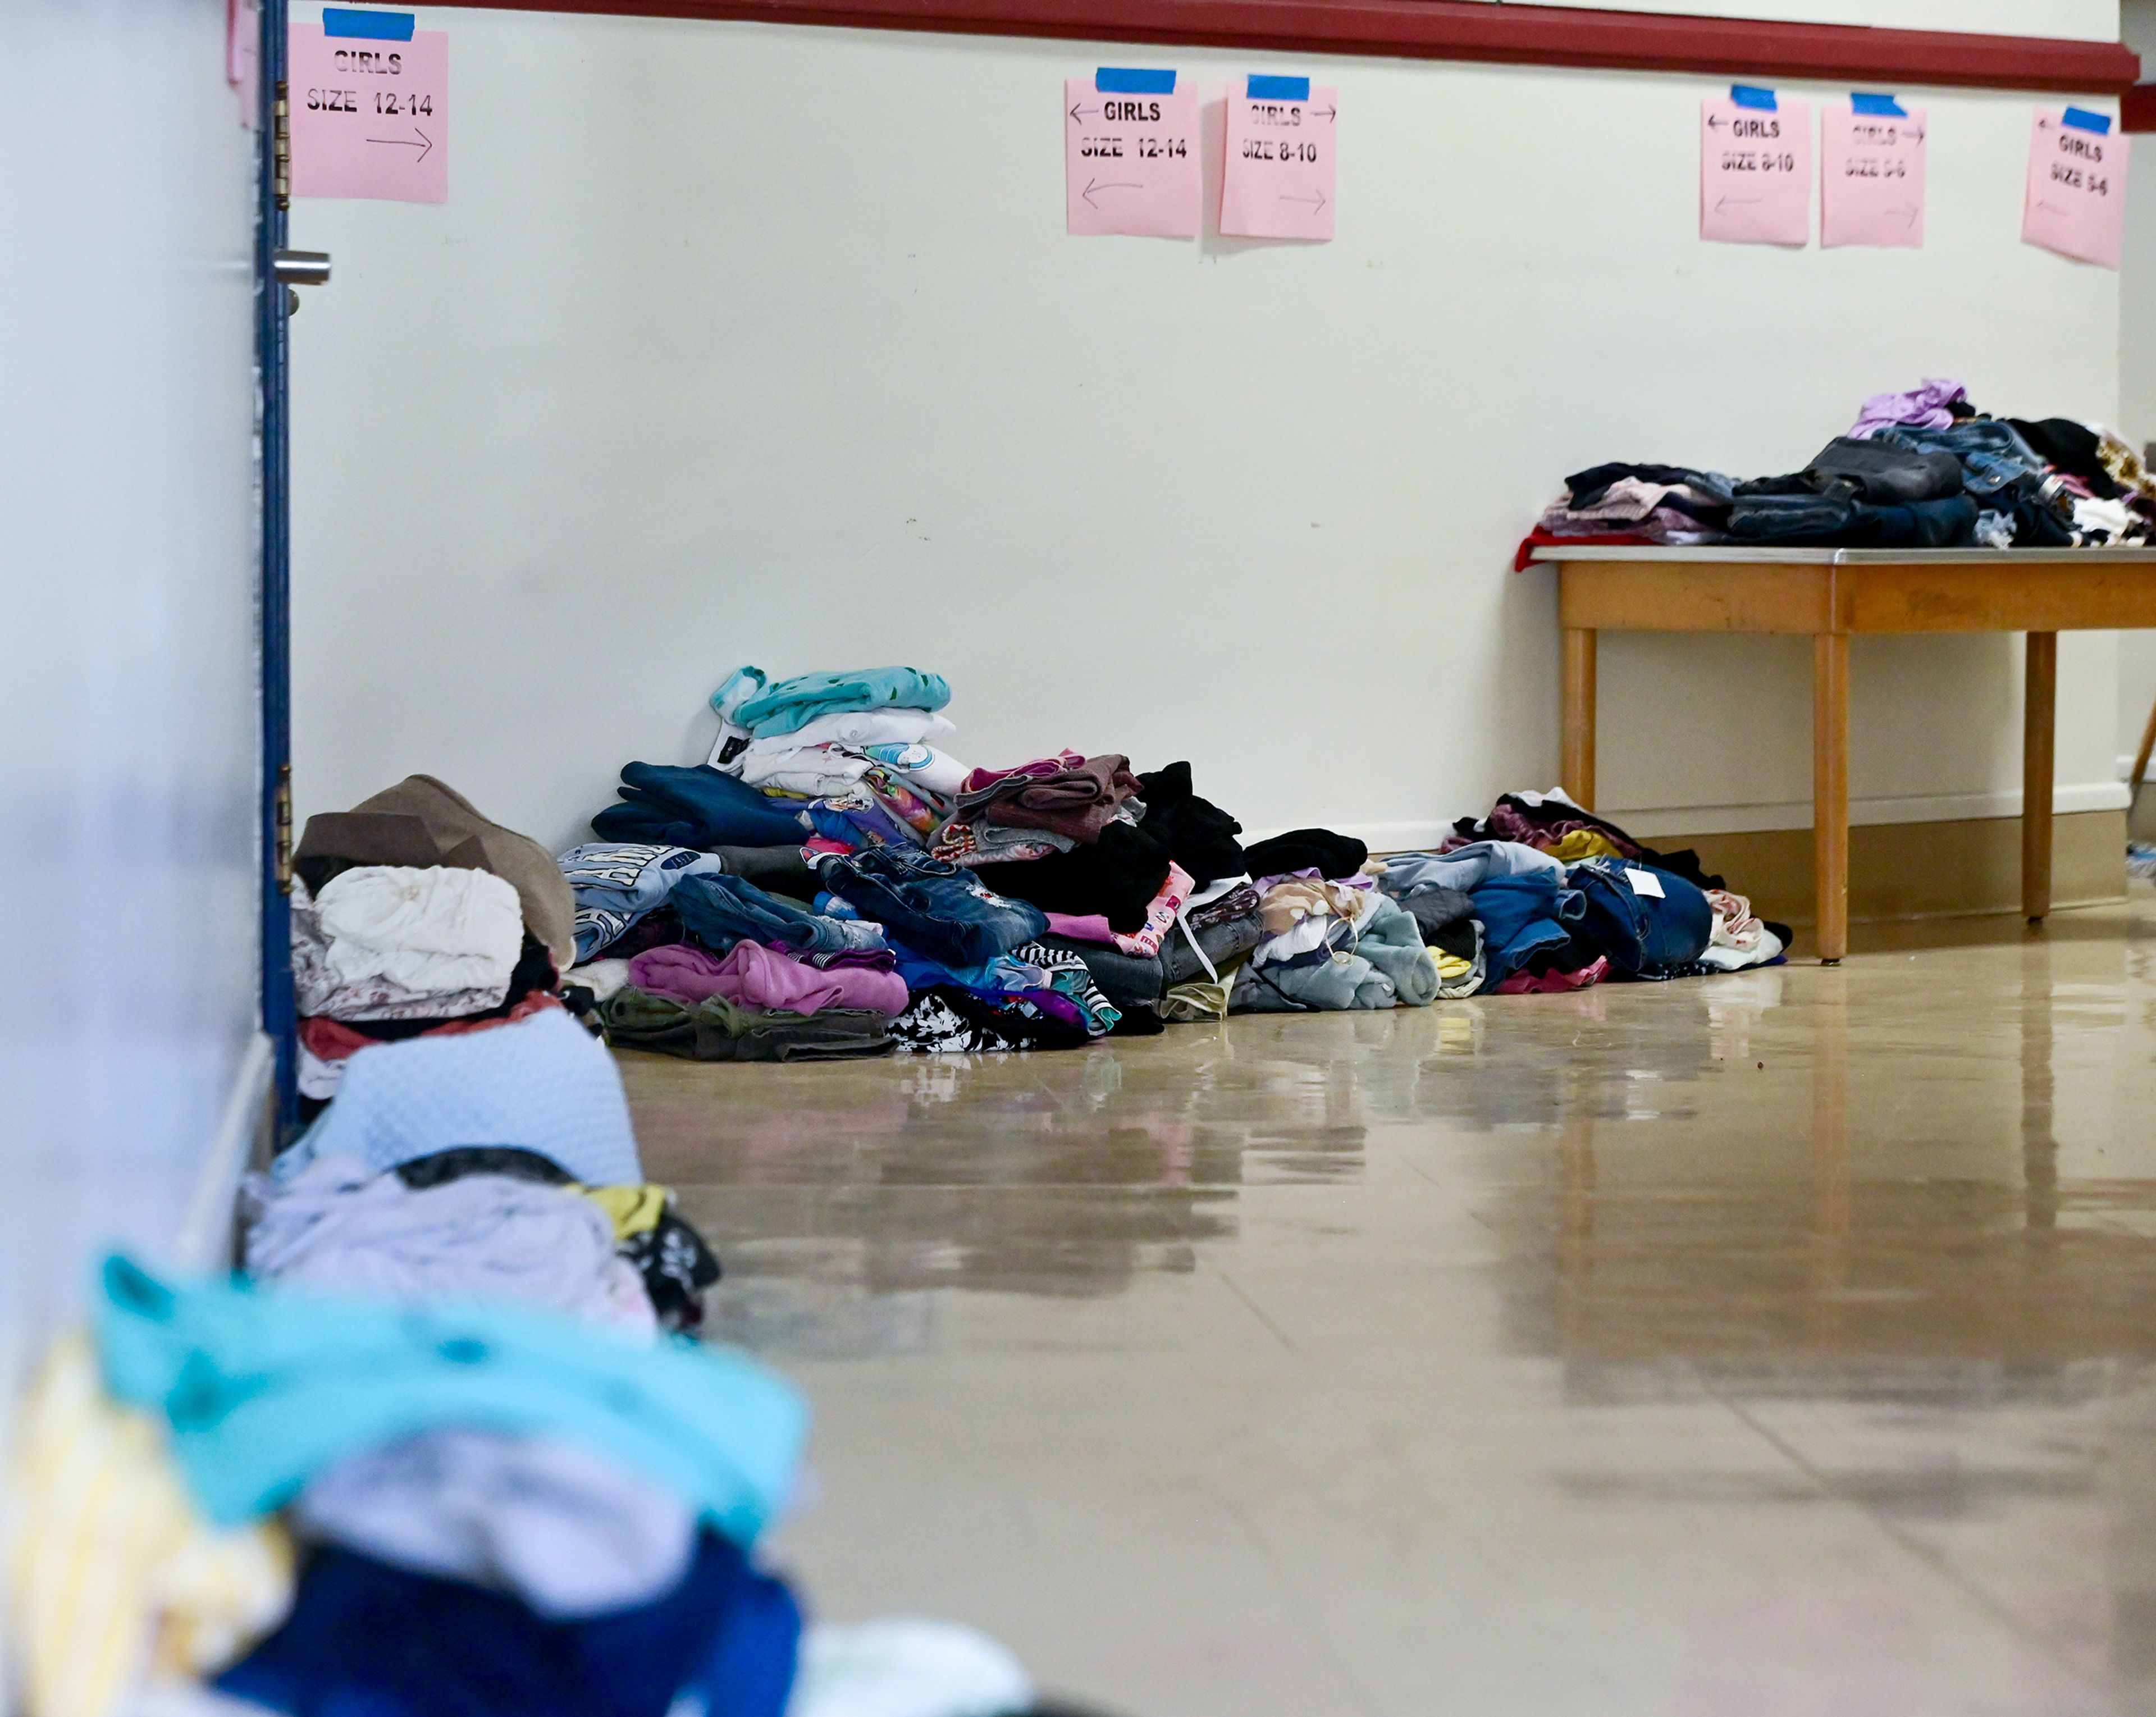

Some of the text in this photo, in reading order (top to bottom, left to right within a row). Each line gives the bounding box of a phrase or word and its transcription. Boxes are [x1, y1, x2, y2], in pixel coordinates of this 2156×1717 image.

[334, 49, 403, 75] GIRLS
[307, 88, 433, 117] SIZE 12-14
[1104, 101, 1161, 122] GIRLS
[1251, 104, 1301, 127] GIRLS
[1733, 119, 1780, 139] GIRLS
[1080, 137, 1187, 159] SIZE 12-14
[1242, 139, 1317, 163] SIZE 8-10
[2058, 134, 2103, 163] GIRLS
